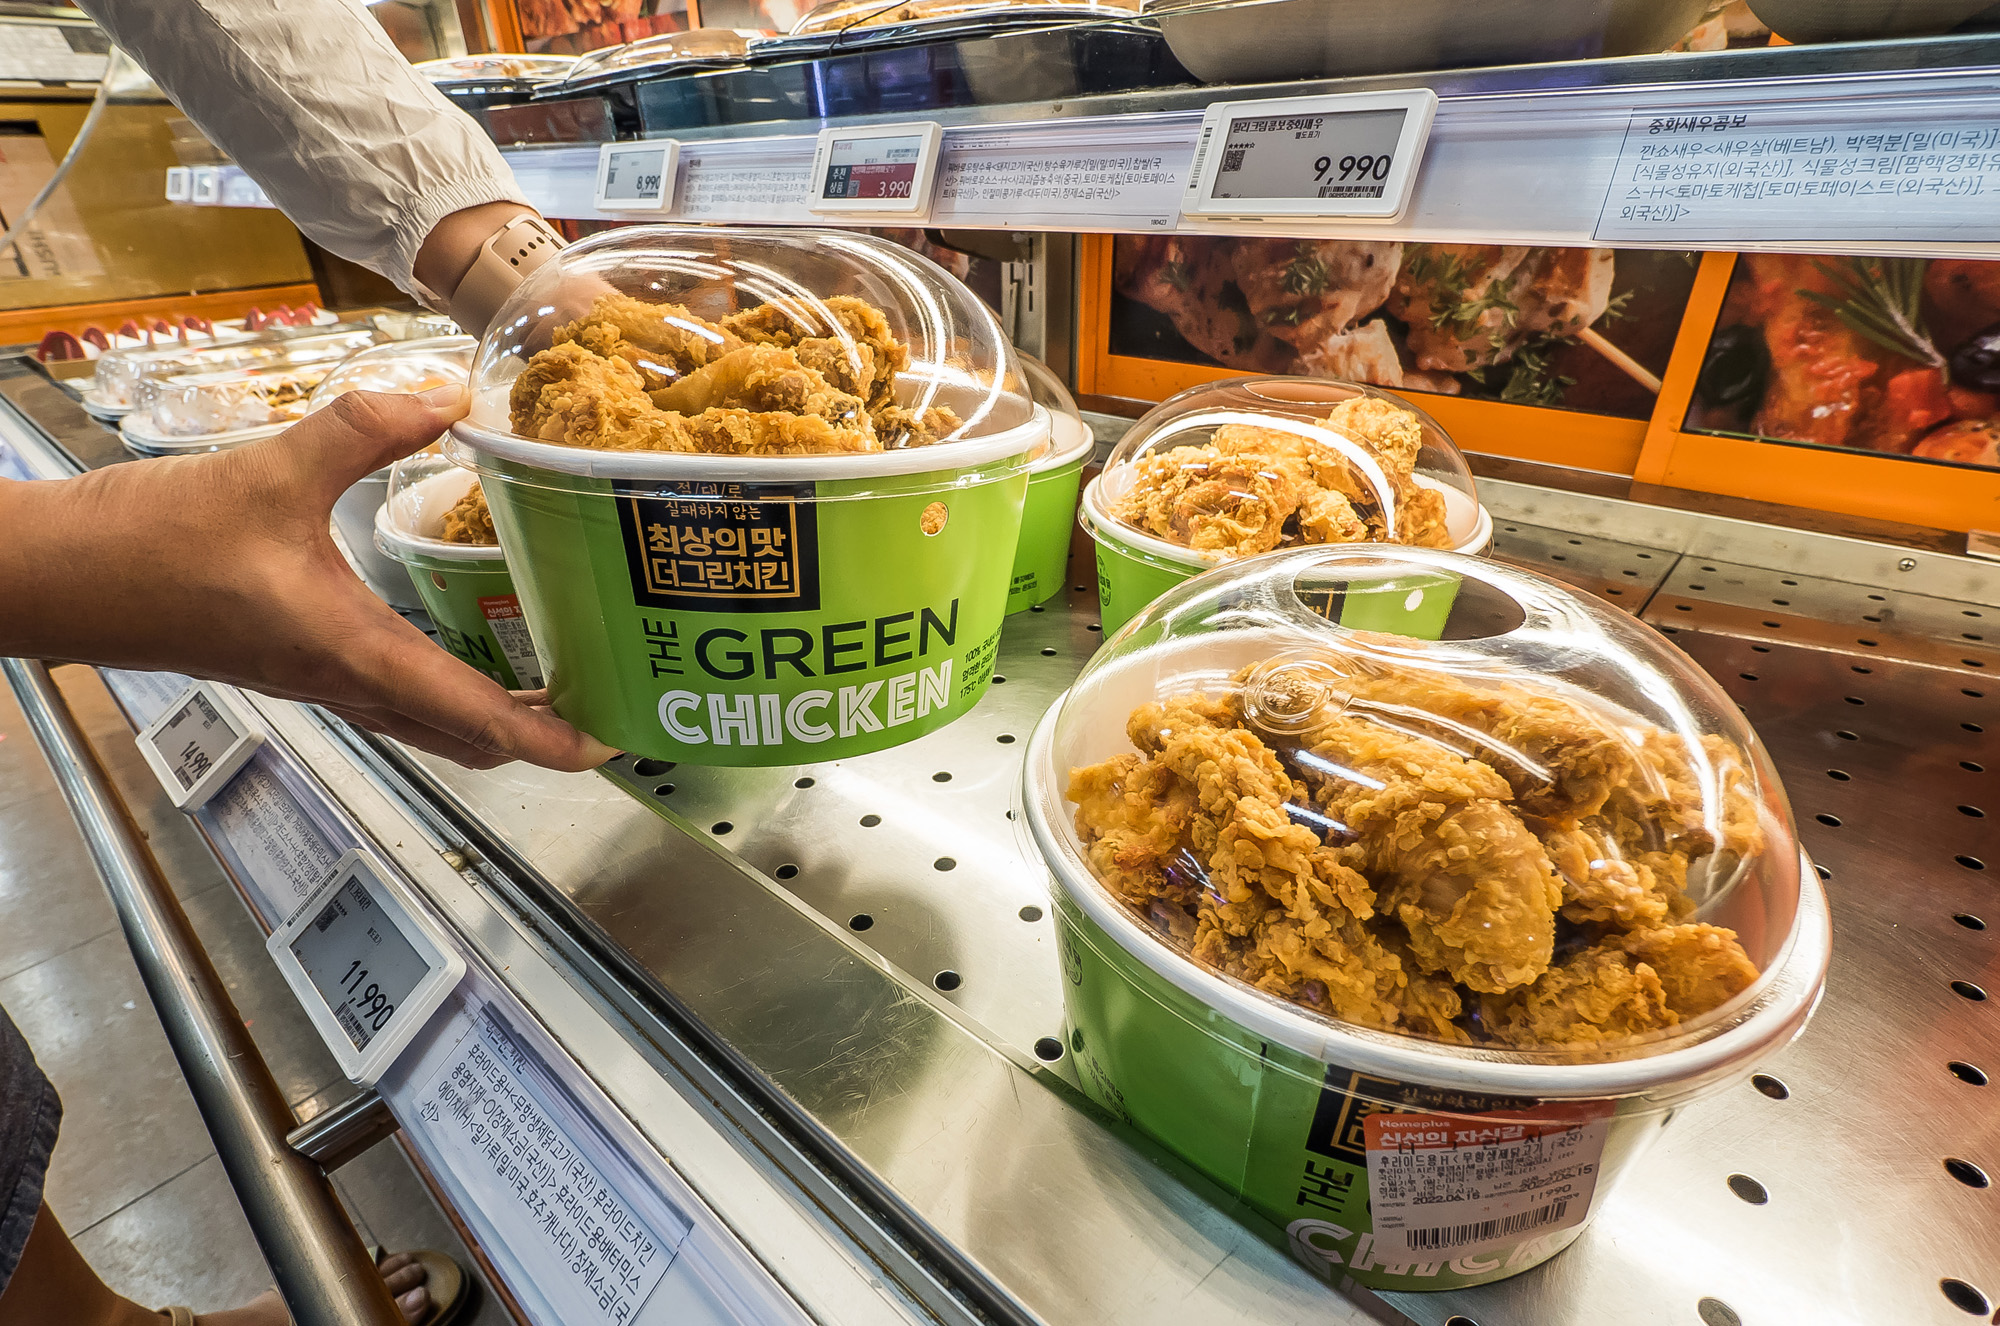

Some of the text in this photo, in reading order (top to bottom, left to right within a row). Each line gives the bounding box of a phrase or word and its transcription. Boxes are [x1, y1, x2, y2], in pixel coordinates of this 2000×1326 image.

[1648, 114, 1748, 134] 중화새우콤보
[833, 167, 847, 180] 추천
[1313, 154, 1392, 185] 9,990
[637, 175, 661, 191] 8,990
[830, 182, 843, 194] 상품
[878, 181, 912, 198] 3,990
[1619, 203, 1690, 222] 외국산)]>
[665, 501, 761, 520] 실패하지 않는
[647, 523, 786, 558] 최상의 맛
[652, 558, 789, 590] 더그린치킨
[642, 617, 684, 679] THE
[694, 598, 959, 681] GREEN
[657, 659, 952, 746] CHICKEN
[180, 740, 213, 780] 14,990
[340, 960, 395, 1032] 11,990
[1379, 1120, 1451, 1130] Homeplus
[1379, 1131, 1448, 1148] 신선의
[1296, 1160, 1355, 1214] THE
[1412, 1191, 1480, 1205] 2022.06.15
